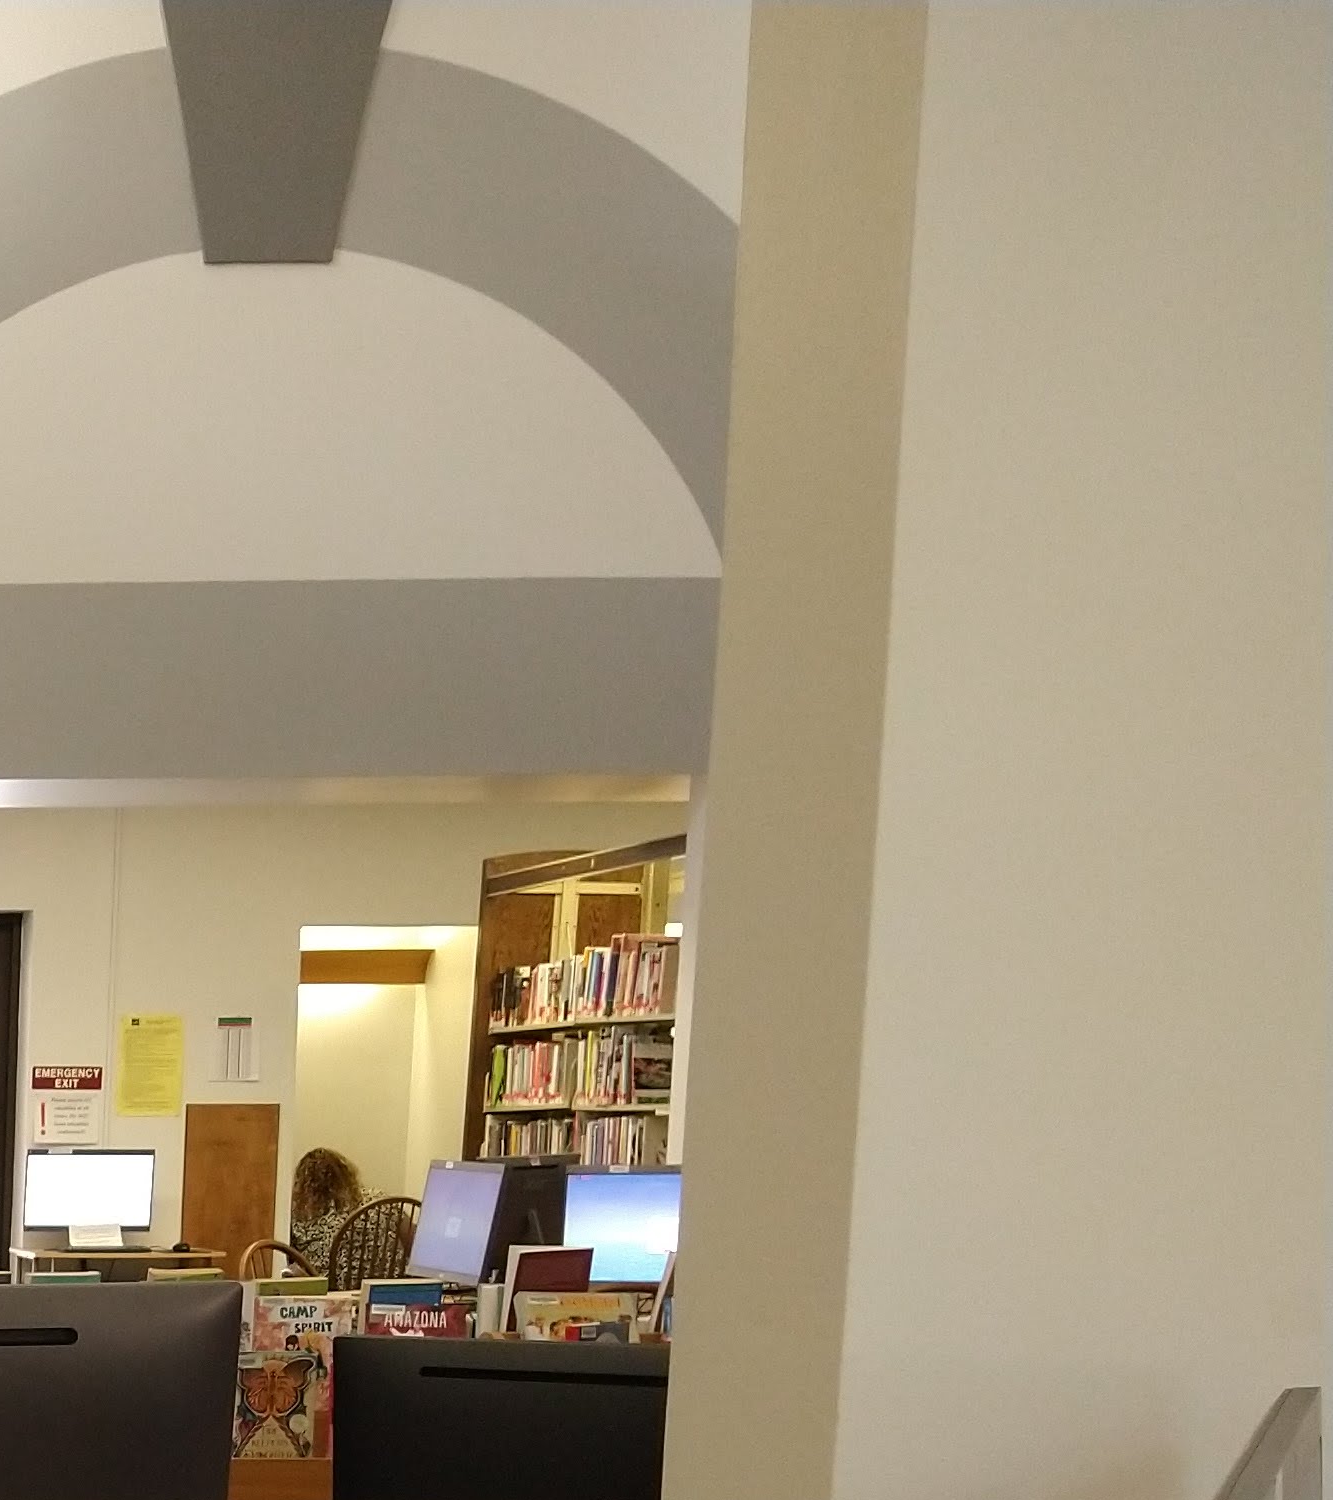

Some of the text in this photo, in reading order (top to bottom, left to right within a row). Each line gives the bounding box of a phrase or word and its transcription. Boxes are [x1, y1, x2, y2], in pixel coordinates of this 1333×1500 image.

[34, 1068, 100, 1079] EMERGENCY
[54, 1078, 80, 1089] EXIT
[279, 1305, 317, 1320] CAMP
[384, 1311, 447, 1329] AMAZONA
[294, 1321, 333, 1334] SPIRIT
